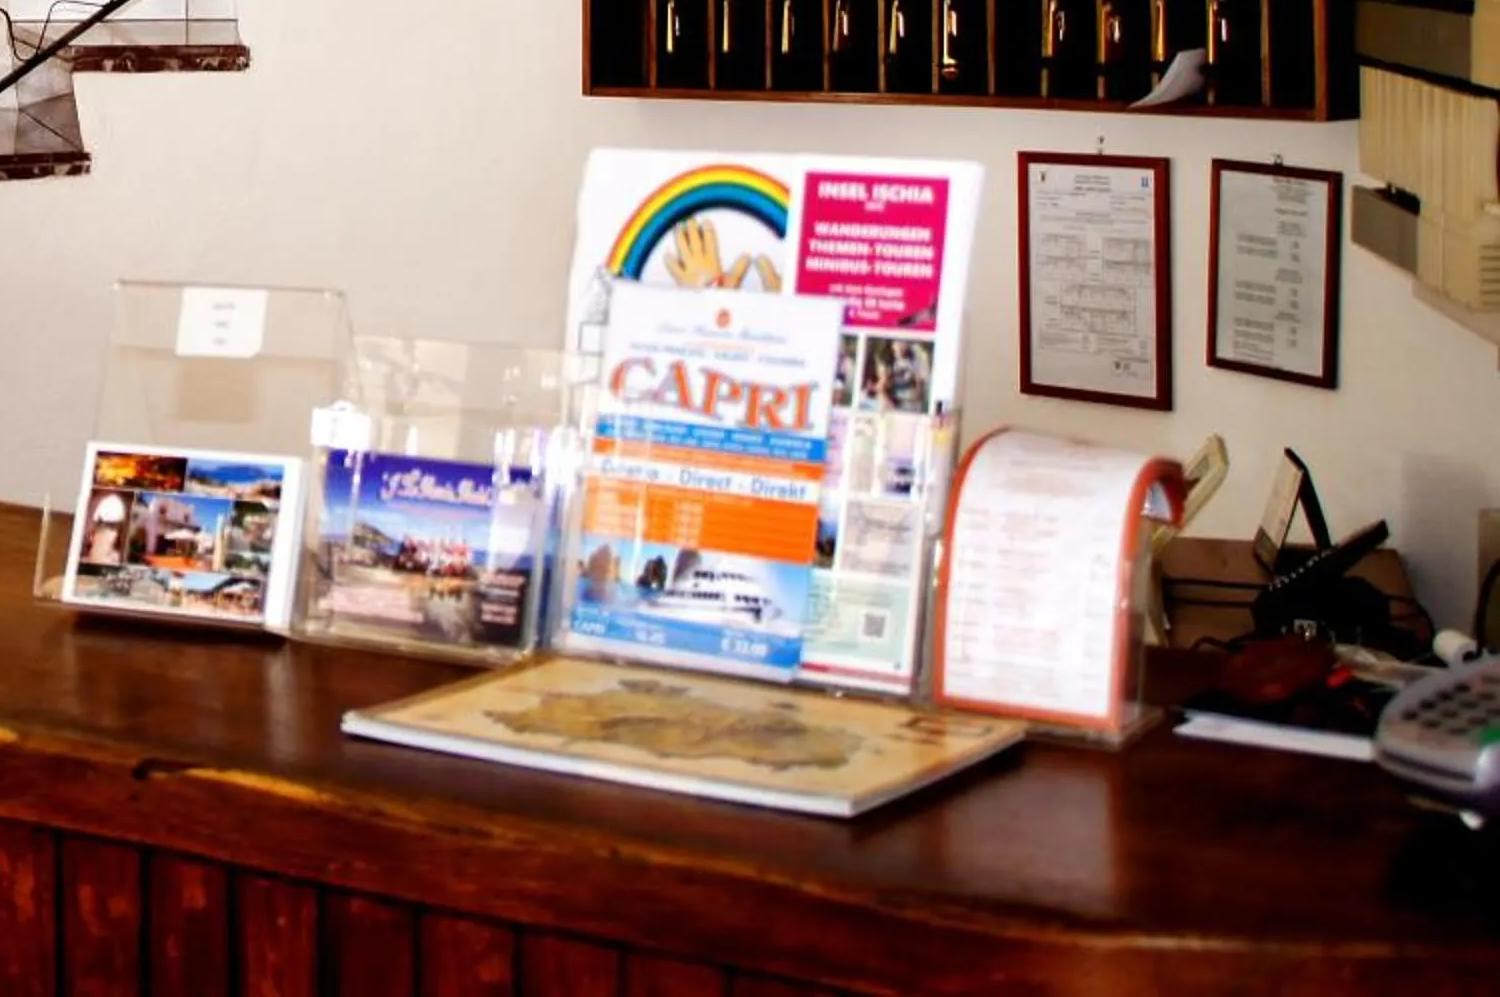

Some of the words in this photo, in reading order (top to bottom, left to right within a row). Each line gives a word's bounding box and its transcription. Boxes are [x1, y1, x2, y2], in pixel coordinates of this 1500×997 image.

[817, 181, 868, 201] INSEL
[871, 183, 933, 204] ISCHIA
[813, 221, 932, 242] WANDERUNGEN
[609, 356, 819, 431] CAPRI
[678, 468, 732, 491] Direct
[750, 476, 808, 500] Direkt
